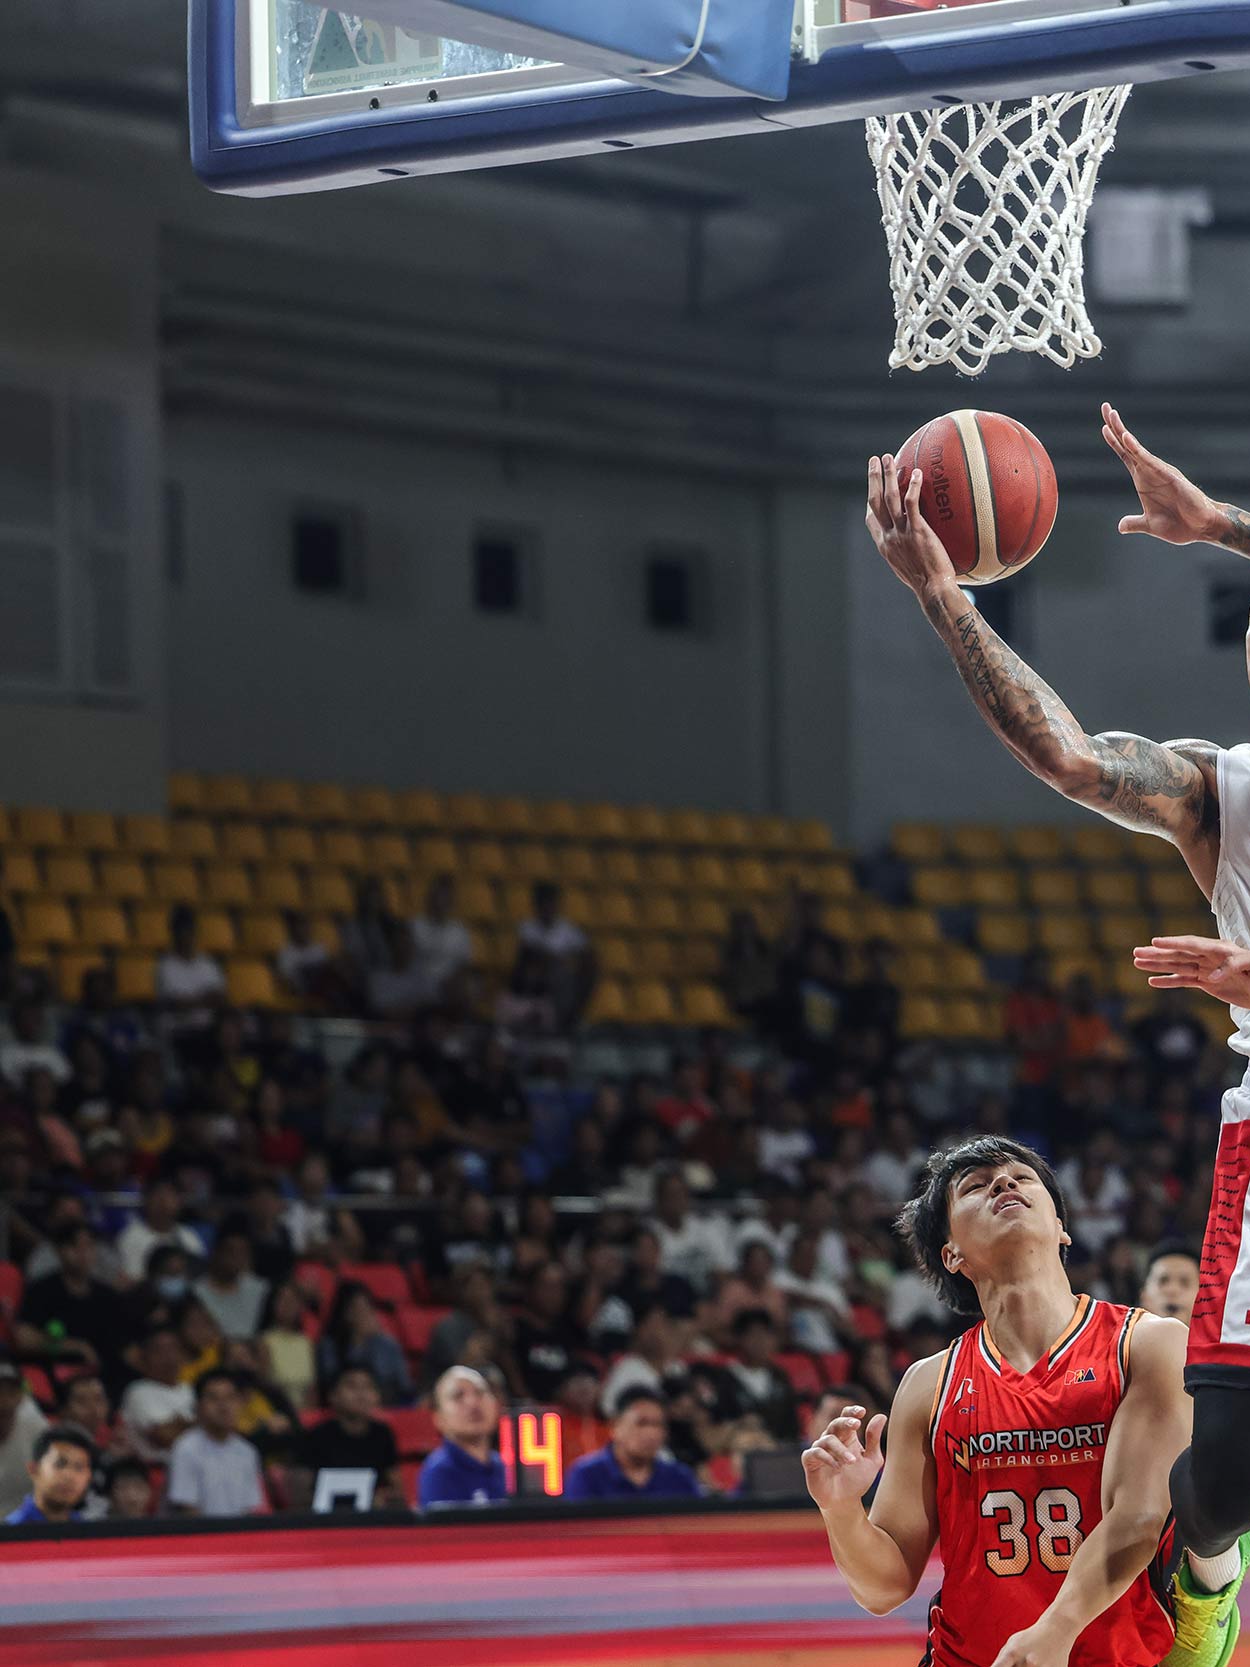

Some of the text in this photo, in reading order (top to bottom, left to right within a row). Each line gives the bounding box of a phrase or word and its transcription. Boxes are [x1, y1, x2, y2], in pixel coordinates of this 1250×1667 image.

[929, 445, 954, 521] molten
[499, 1412, 563, 1496] 14
[968, 1422, 1107, 1458] NORTHPORT
[980, 1487, 1086, 1578] 38
